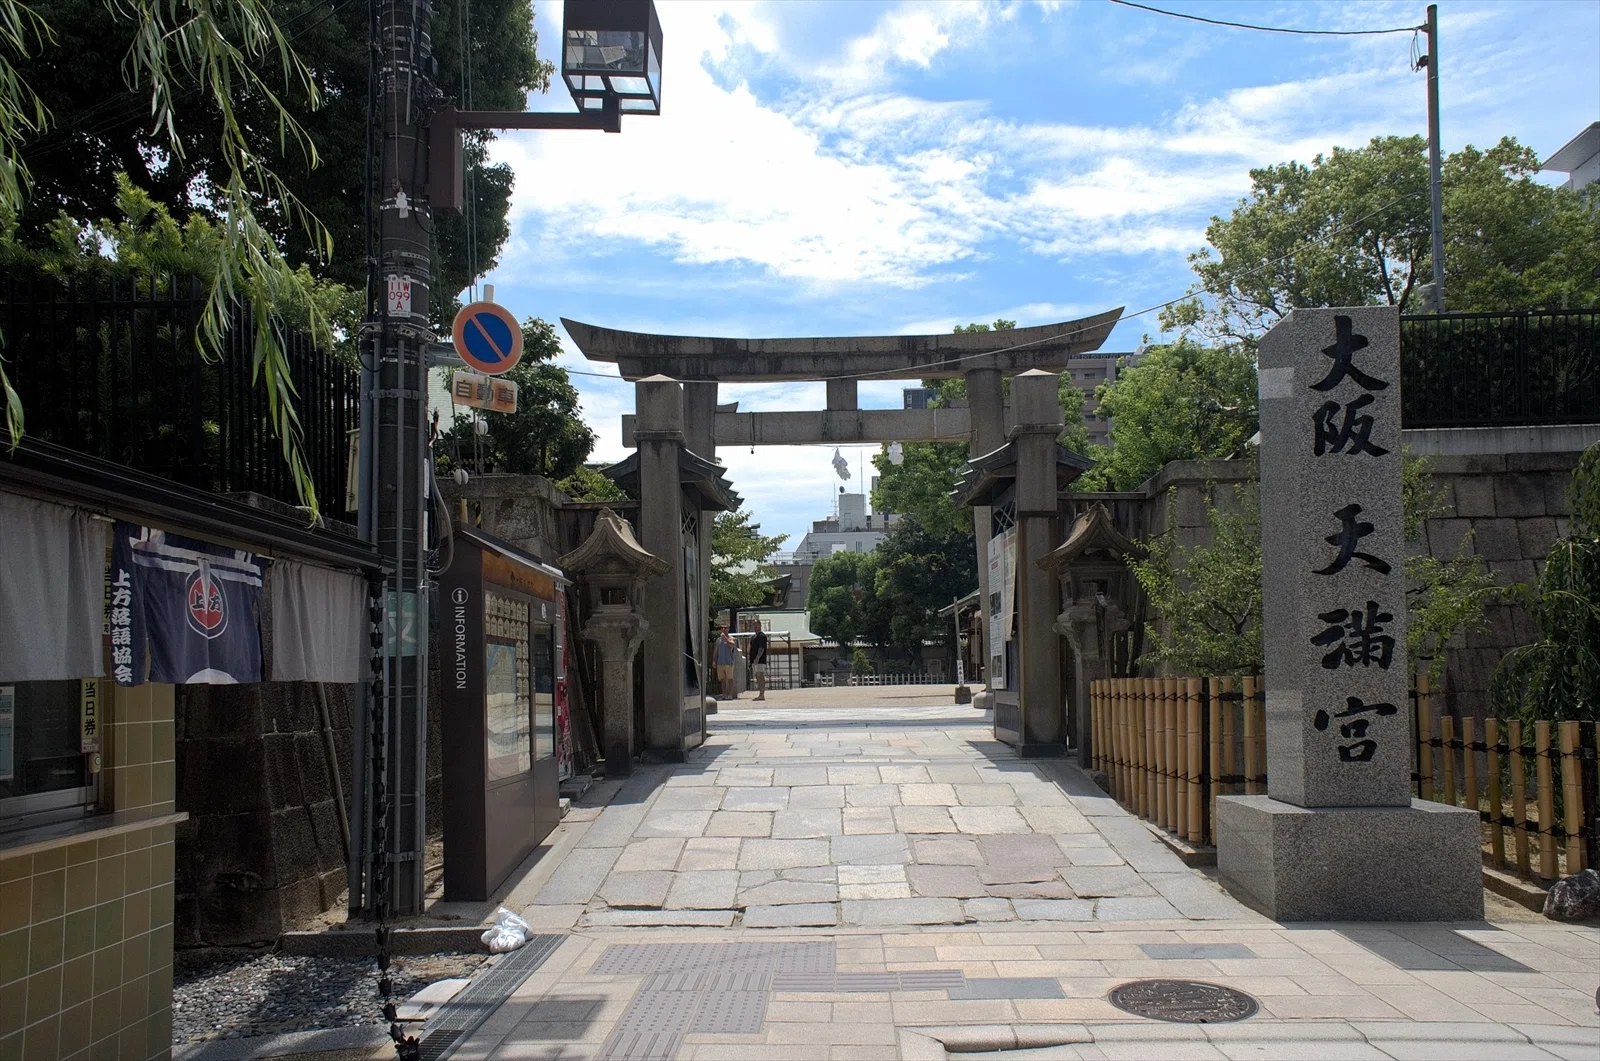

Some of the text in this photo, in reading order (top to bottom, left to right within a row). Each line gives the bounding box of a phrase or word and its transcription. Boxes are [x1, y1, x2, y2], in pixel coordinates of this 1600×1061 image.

[389, 291, 410, 301] 099
[396, 301, 403, 310] A
[457, 381, 514, 404] 自動車
[1309, 314, 1399, 764] 大阪天満宮
[111, 569, 133, 683] 上方落語協会
[454, 606, 467, 689] INFORMATION
[84, 681, 96, 735] 当日券
